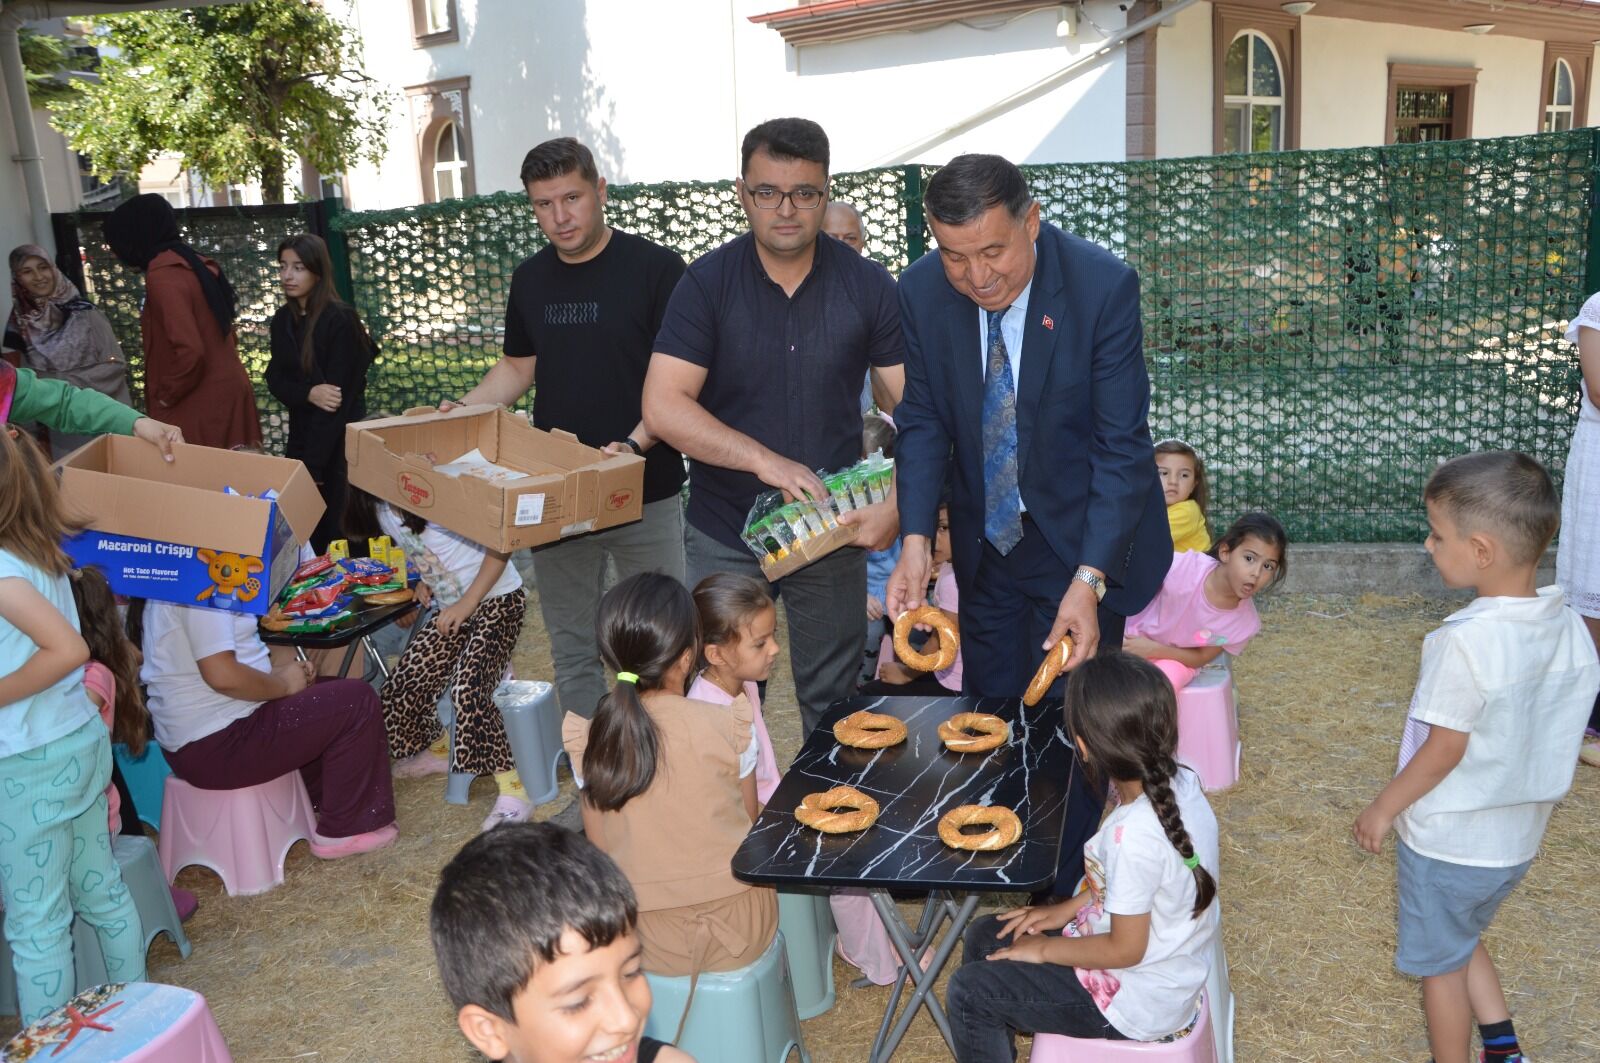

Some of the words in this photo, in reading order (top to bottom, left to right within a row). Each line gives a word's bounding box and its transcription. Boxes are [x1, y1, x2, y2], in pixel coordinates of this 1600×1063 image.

[98, 540, 152, 554] Macaroni
[155, 543, 193, 559] Crispy
[151, 568, 179, 576] Flavored
